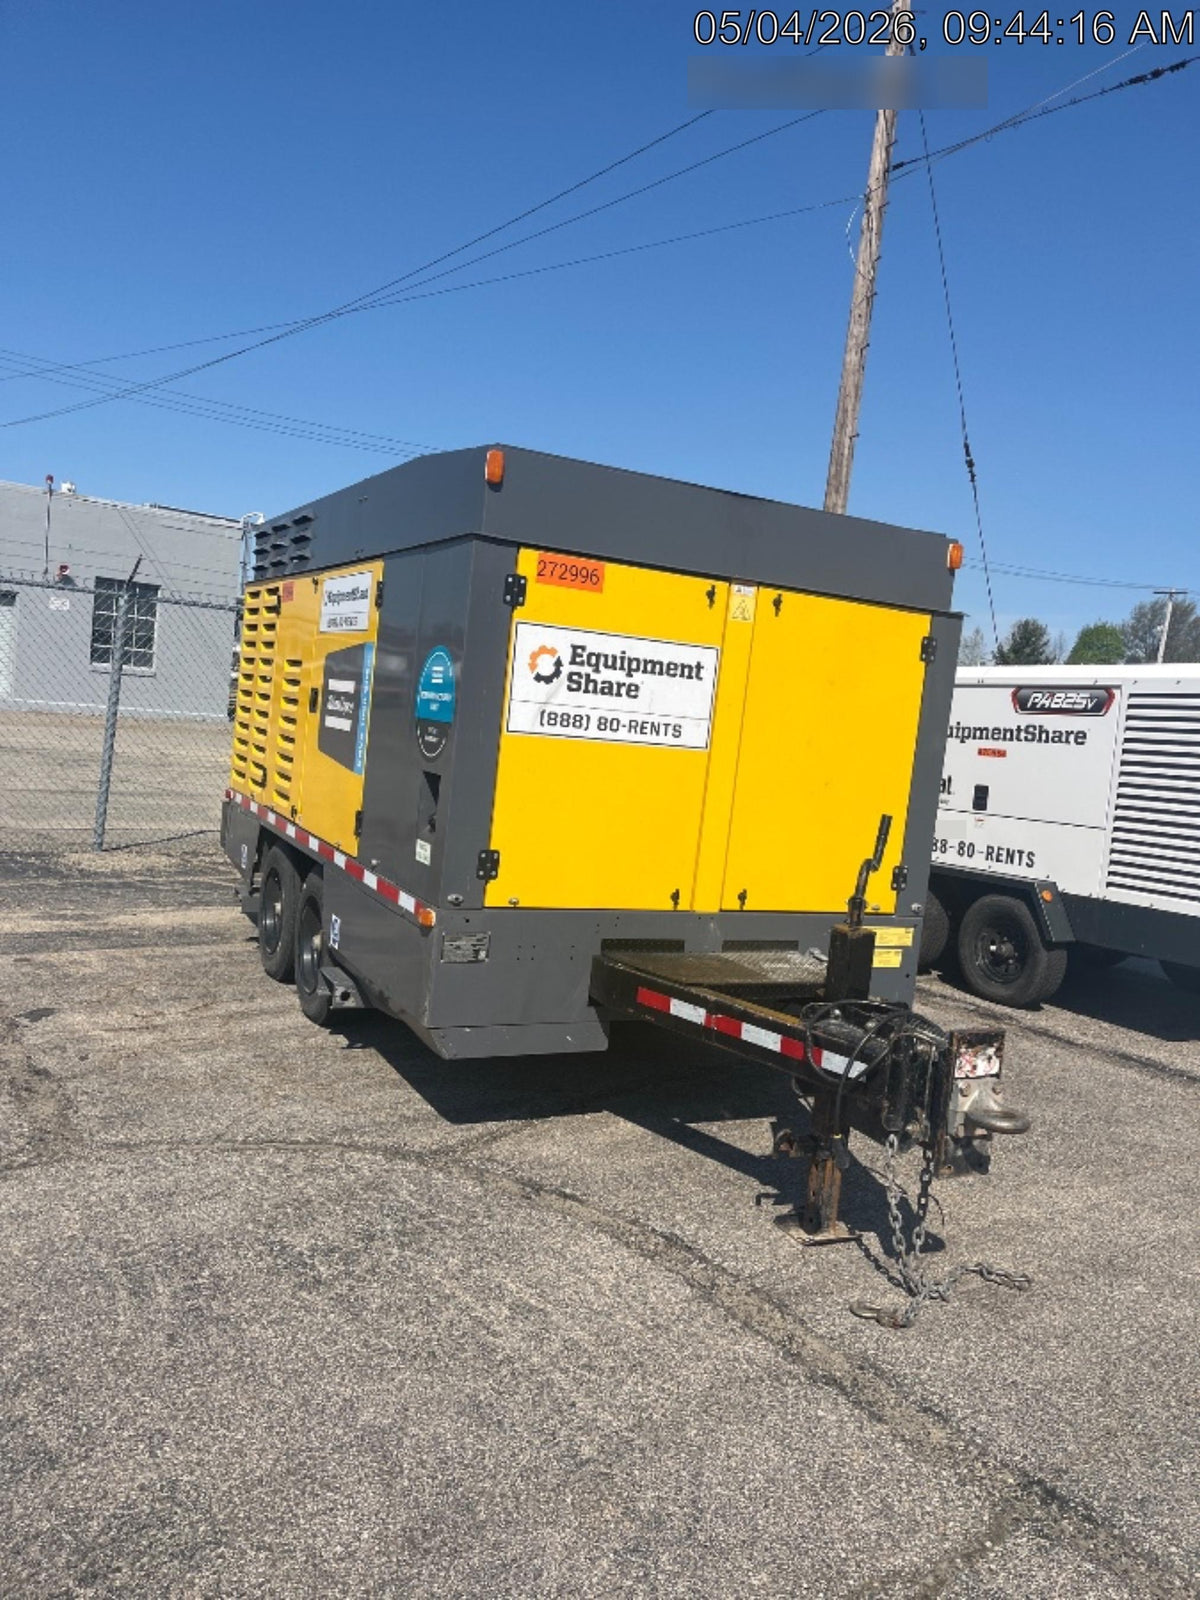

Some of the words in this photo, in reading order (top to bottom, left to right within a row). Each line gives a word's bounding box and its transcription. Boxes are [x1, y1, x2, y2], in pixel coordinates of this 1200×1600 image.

[536, 559, 600, 586] 272996
[568, 643, 705, 681] Equipment
[566, 671, 640, 699] Share
[539, 708, 591, 731] (888)
[596, 716, 683, 739] 80-RENTS
[947, 722, 1087, 746] uipmentShare
[932, 837, 1036, 868] 88-80-RENTS
